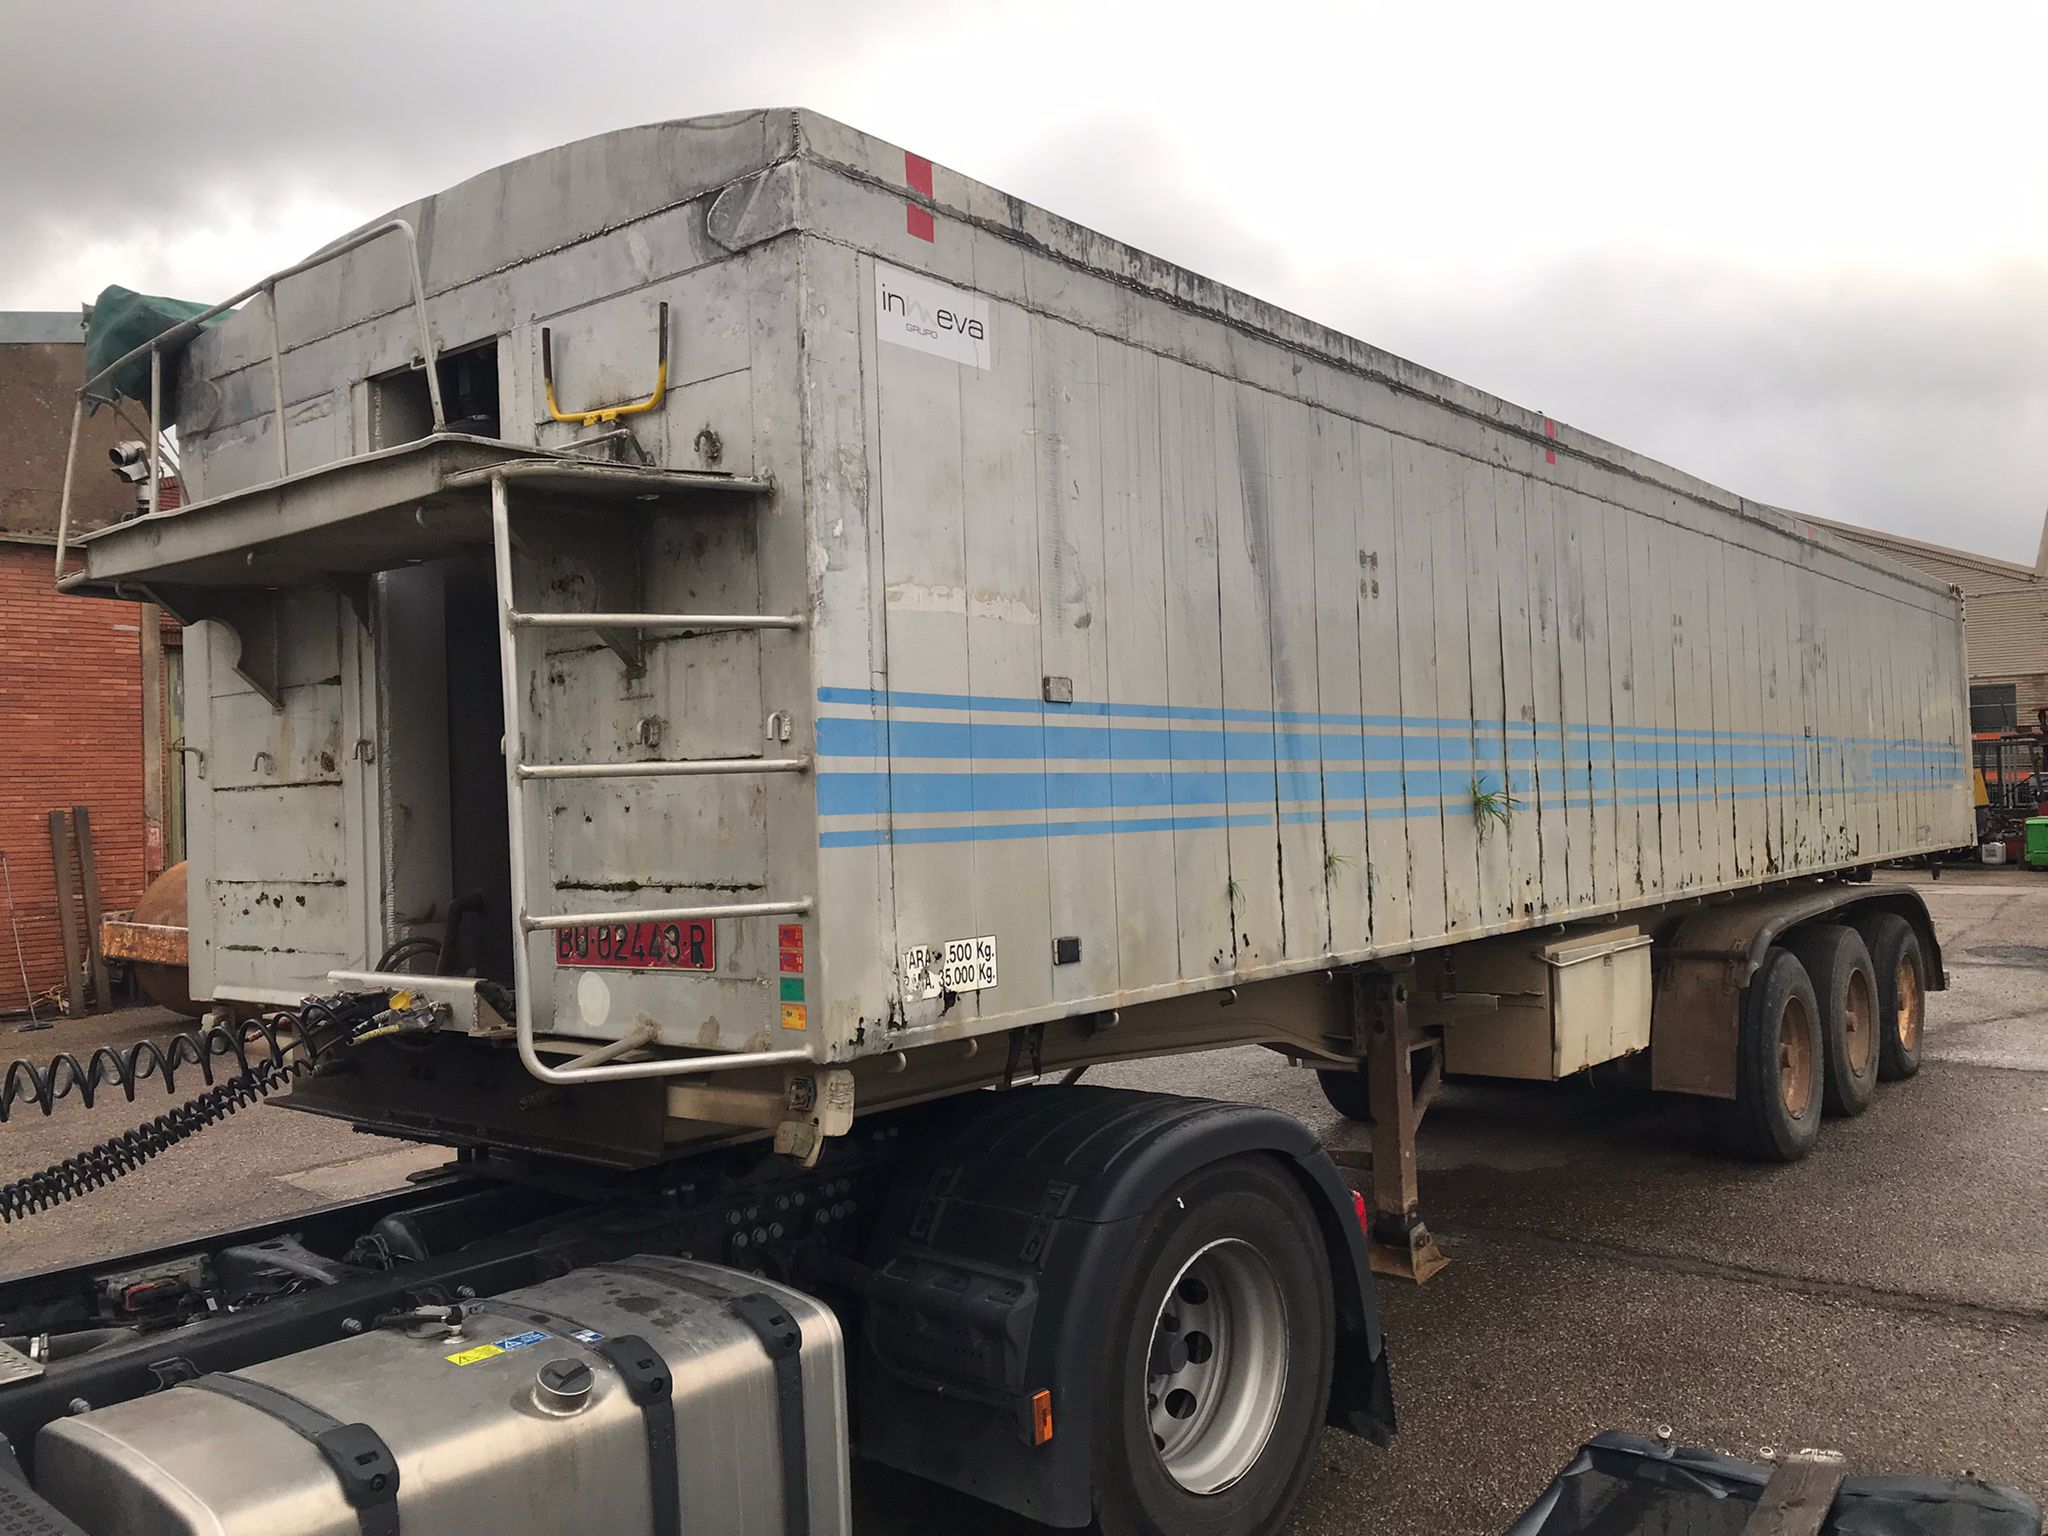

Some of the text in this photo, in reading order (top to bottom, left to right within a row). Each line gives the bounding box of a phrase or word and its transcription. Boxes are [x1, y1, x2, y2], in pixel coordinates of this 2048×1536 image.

[905, 323, 938, 340] GRUPO
[976, 940, 995, 962] Kg.
[938, 965, 975, 988] 35.000
[978, 962, 995, 983] Kg.
